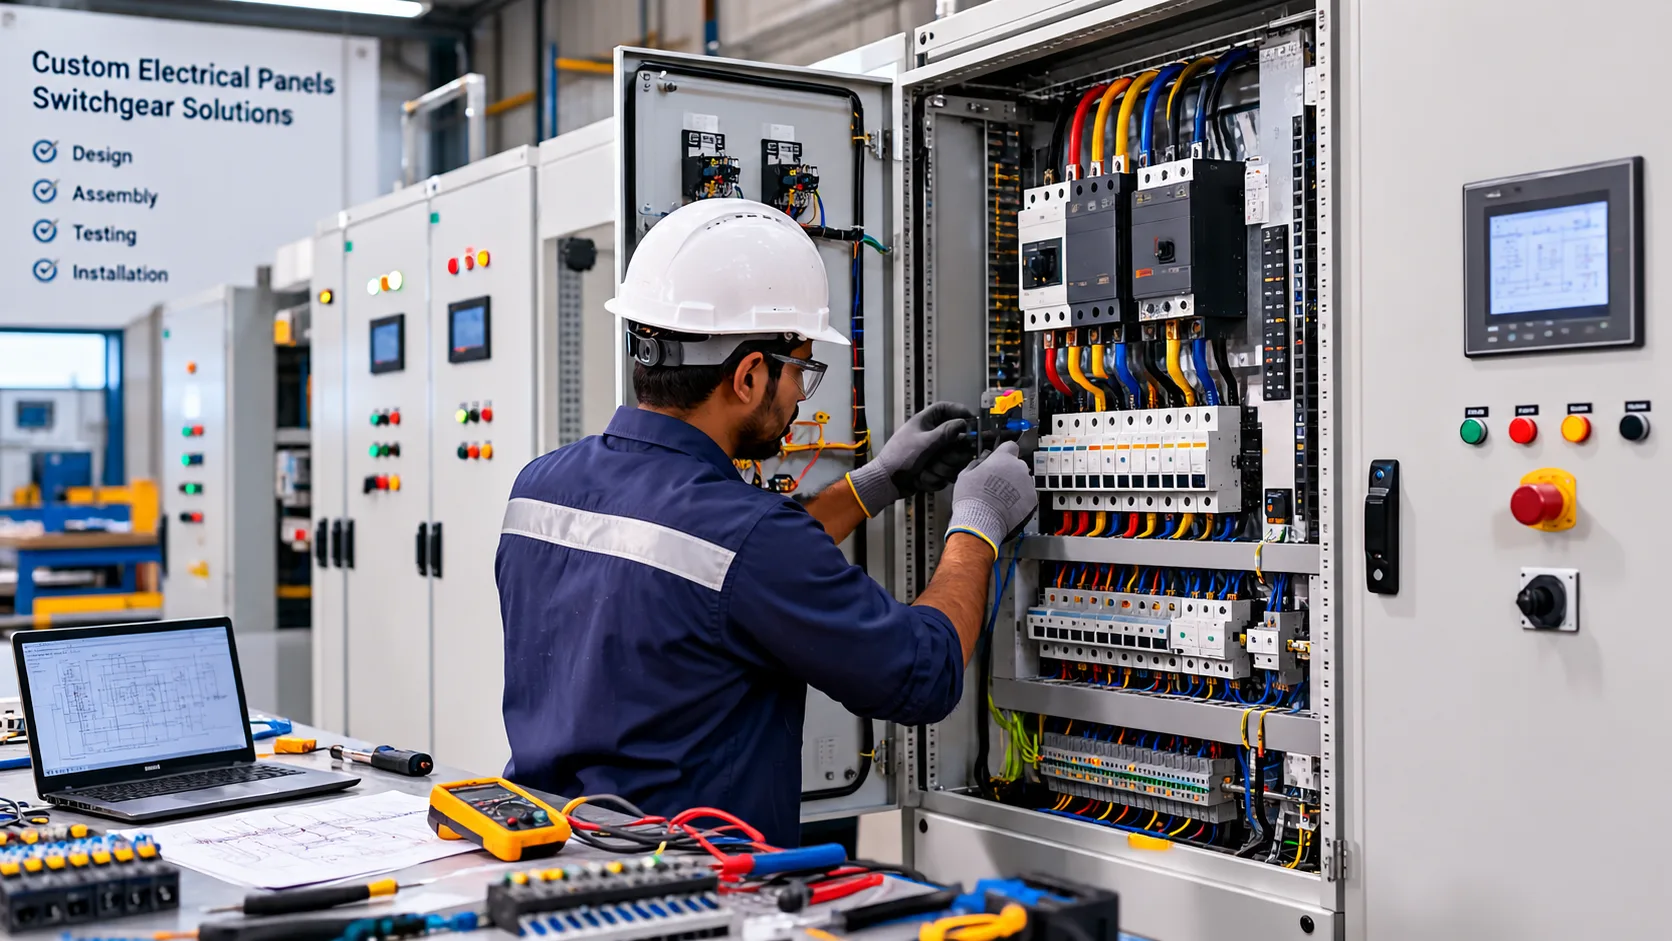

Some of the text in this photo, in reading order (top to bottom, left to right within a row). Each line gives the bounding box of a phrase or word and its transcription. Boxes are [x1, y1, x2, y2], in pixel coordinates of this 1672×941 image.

[33, 50, 335, 95] Custom Electrical Panels
[33, 86, 293, 126] Switchgear Solutions
[73, 145, 133, 168] Design
[73, 185, 158, 209] Assembly
[73, 224, 137, 247] Testing
[73, 265, 169, 283] Installation
